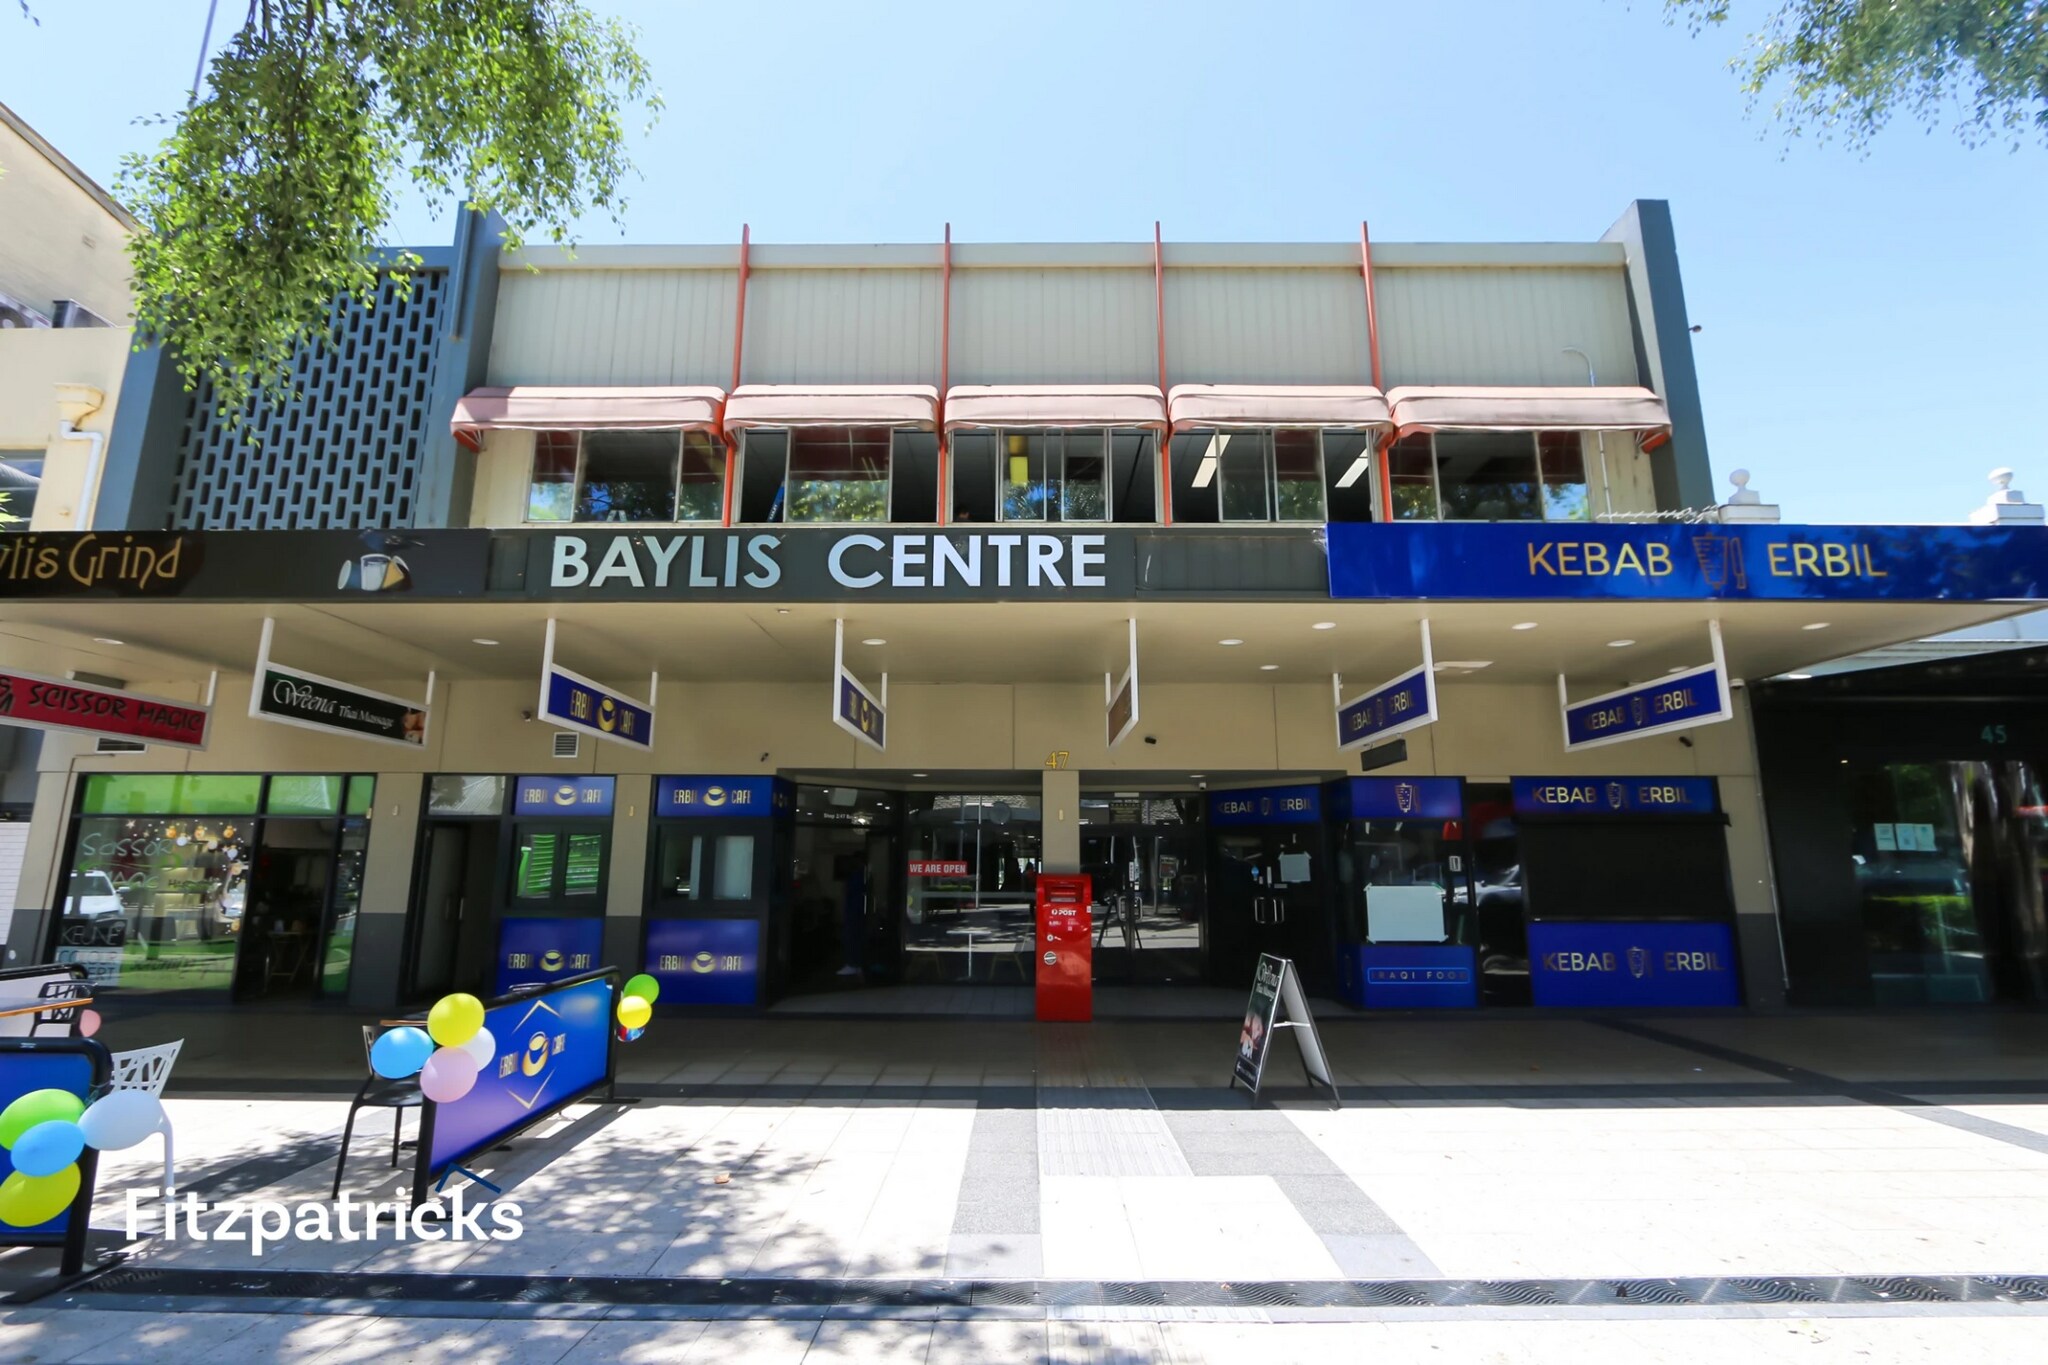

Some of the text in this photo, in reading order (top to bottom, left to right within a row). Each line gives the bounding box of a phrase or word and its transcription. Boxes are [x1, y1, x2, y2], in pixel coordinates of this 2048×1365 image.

[68, 533, 182, 589] Grind
[550, 534, 1106, 588] BAYLIS CENTRE
[1527, 542, 1888, 577] KEBAB ERBIL
[28, 683, 201, 732] SCISSOR MAGIC
[273, 679, 337, 714] Weena
[1653, 688, 1698, 714] ERBIL
[1981, 725, 2007, 743] 45
[1045, 751, 1069, 769] 47
[1532, 786, 1692, 803] KEBAB ERBIL
[910, 863, 966, 873] WE ARE OPEN
[1543, 952, 1725, 971] KEBAB ERBIL
[1372, 970, 1415, 980] IRAQI
